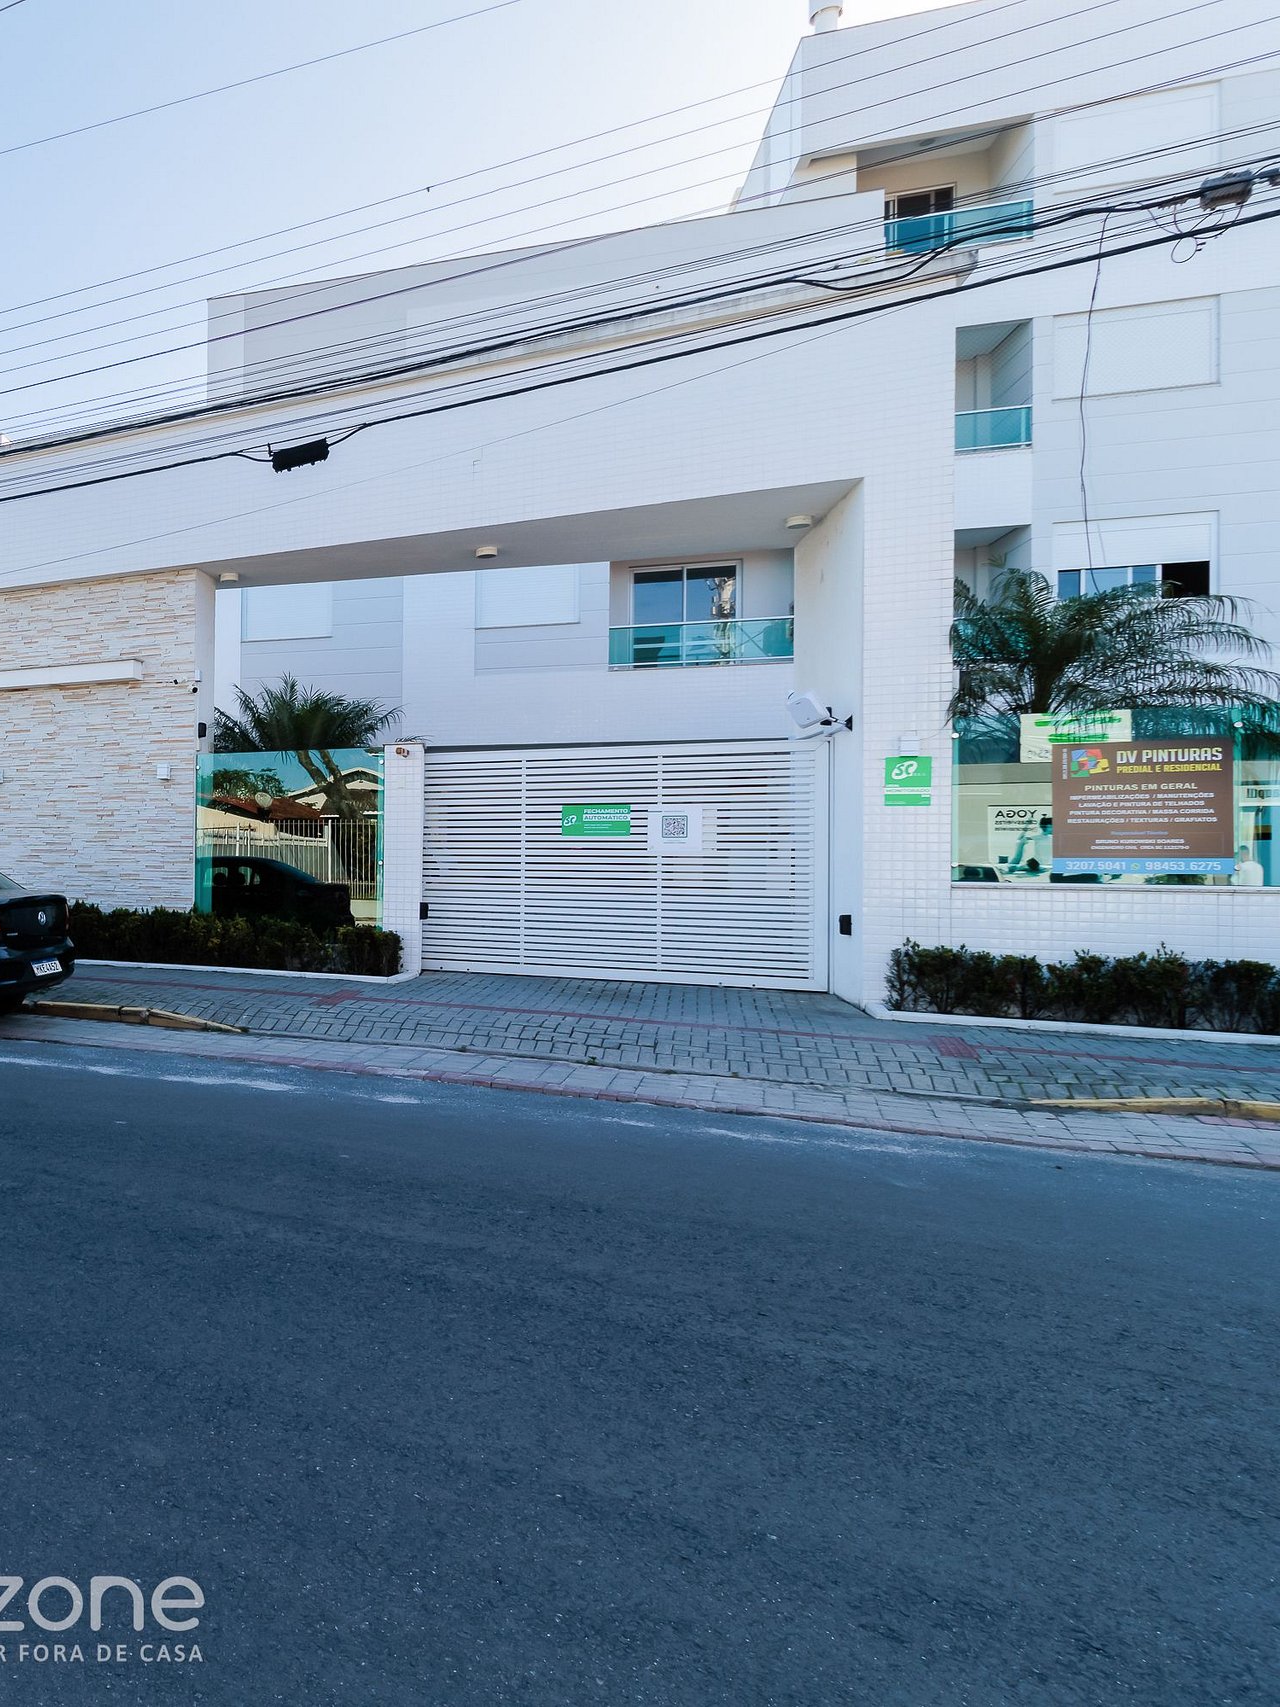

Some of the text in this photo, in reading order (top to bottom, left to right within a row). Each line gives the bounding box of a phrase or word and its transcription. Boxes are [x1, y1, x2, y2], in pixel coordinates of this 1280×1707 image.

[1116, 747, 1223, 764] DV PINTURAS
[1116, 763, 1223, 774] PREDIAL E RESIDENCIAL
[1084, 783, 1139, 791] PINTURAS
[1160, 782, 1198, 790] GERAL
[1066, 861, 1222, 871] 3207.5041 98453.6275
